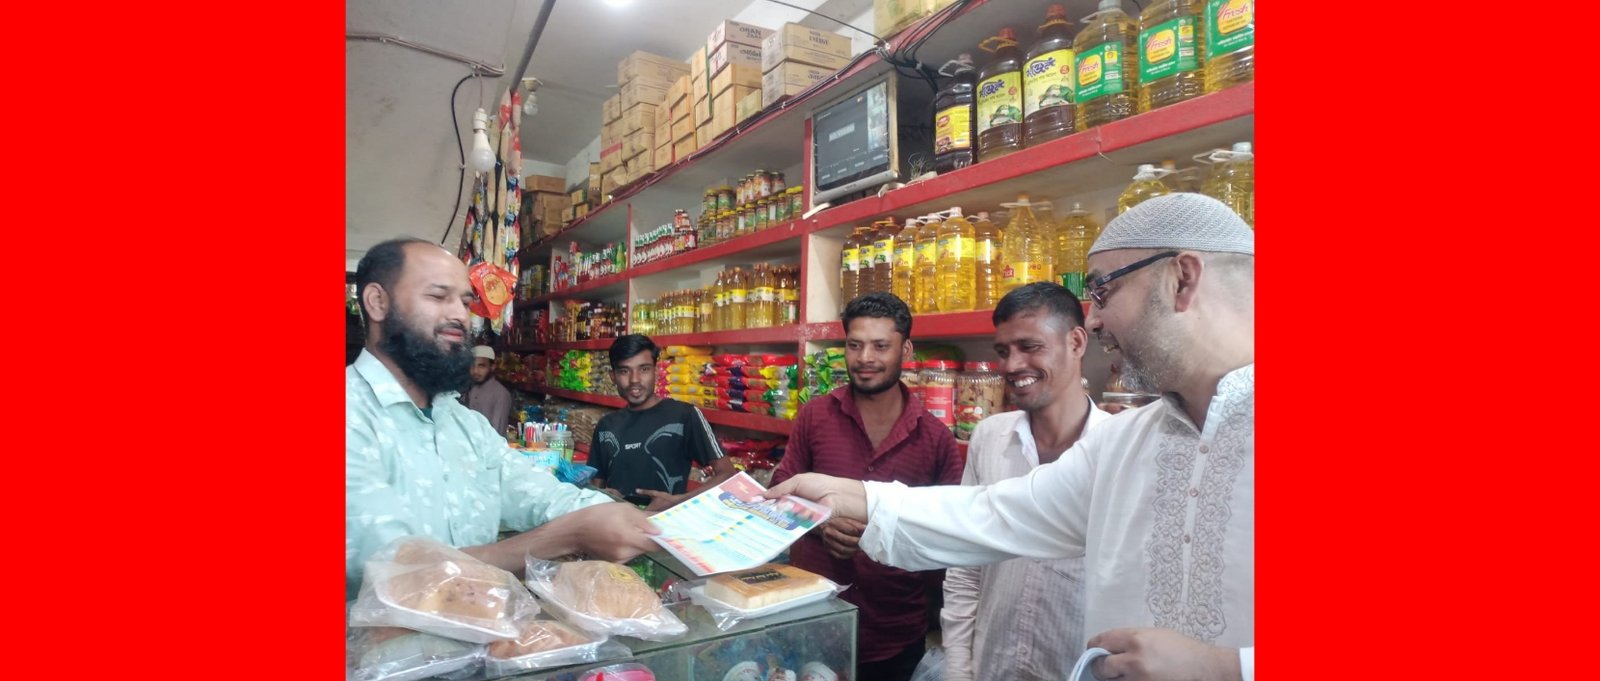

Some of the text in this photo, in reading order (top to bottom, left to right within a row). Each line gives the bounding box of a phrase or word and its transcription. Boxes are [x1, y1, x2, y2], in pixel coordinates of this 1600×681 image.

[1219, 3, 1248, 20] Fresh
[1147, 35, 1172, 50] Fresh
[1080, 58, 1099, 73] Fresh
[625, 442, 642, 450] SPORT
